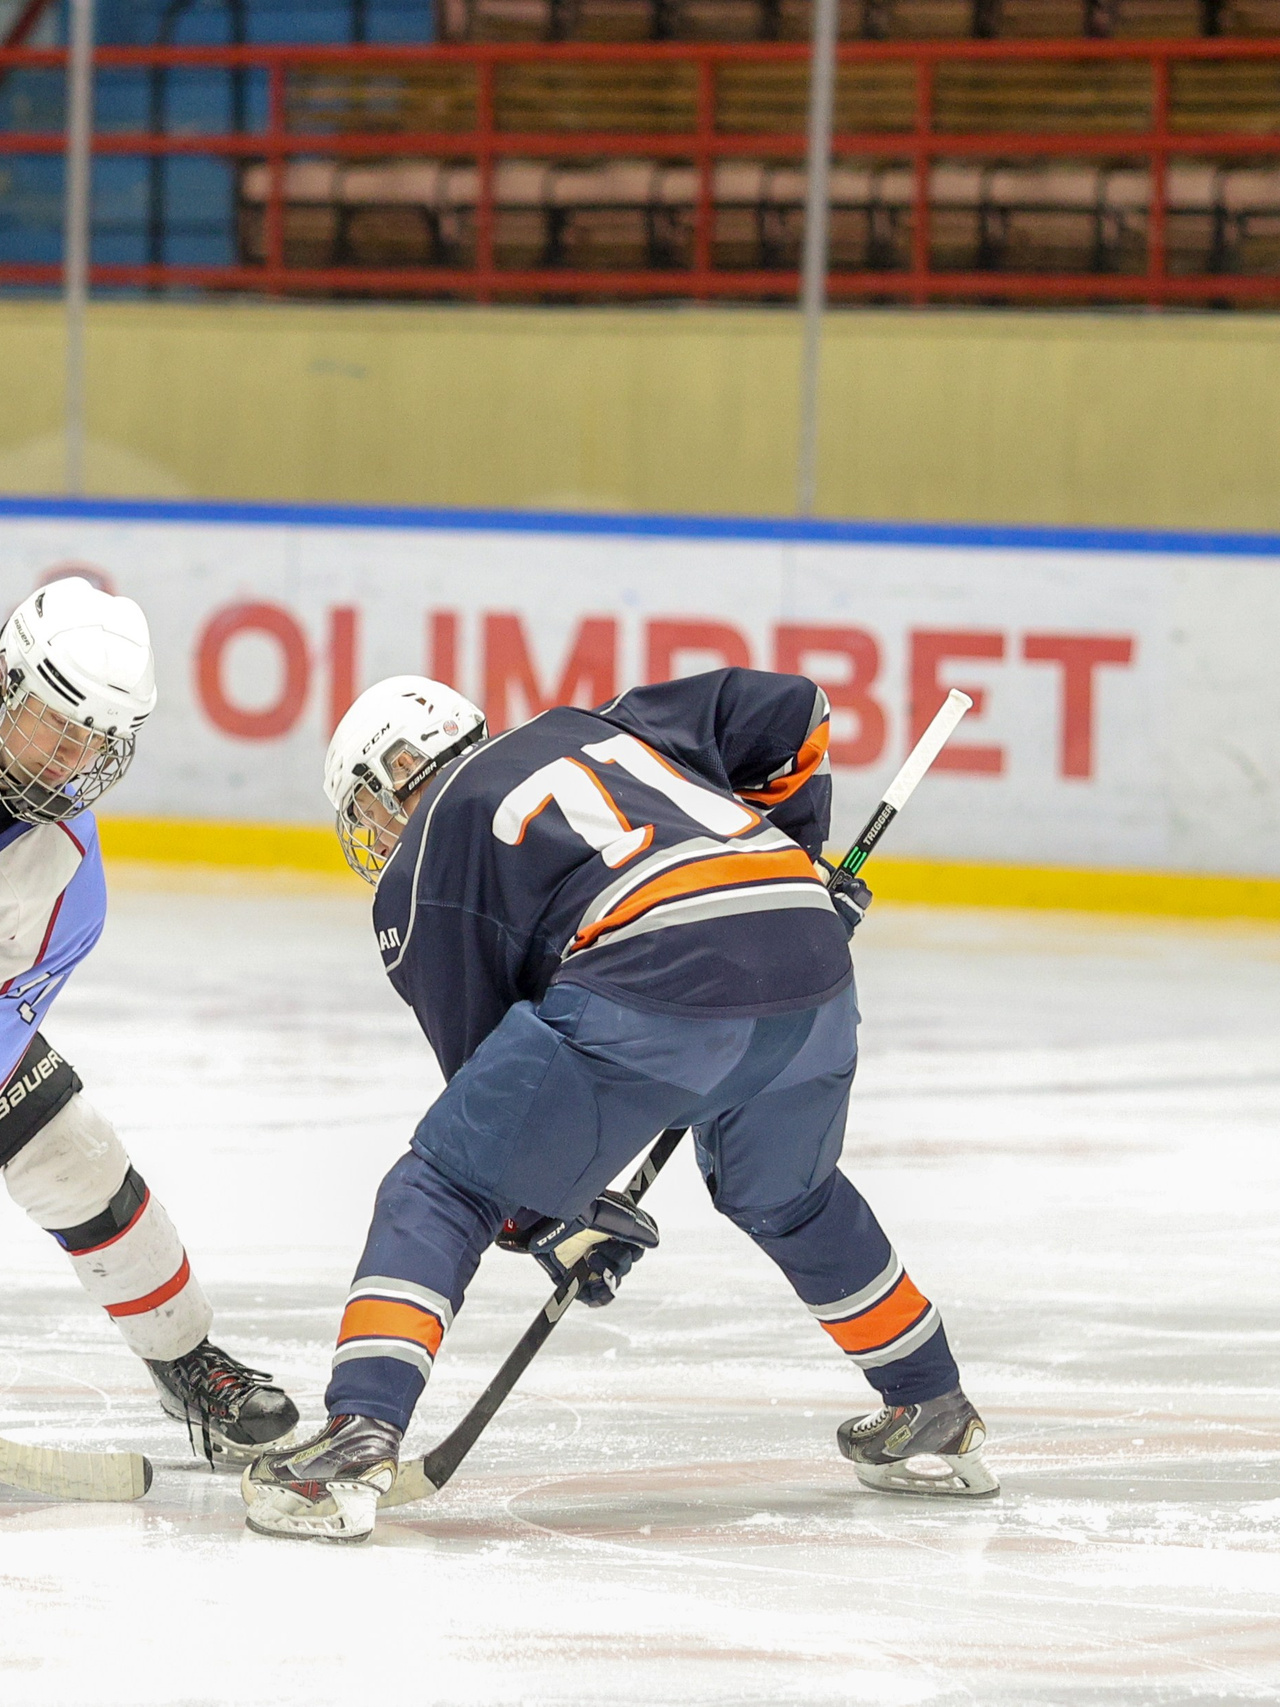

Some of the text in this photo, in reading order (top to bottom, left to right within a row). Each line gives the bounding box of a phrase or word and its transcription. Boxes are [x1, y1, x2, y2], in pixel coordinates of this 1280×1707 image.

[13, 618, 31, 647] BAUER
[362, 722, 390, 755] CCM
[407, 760, 438, 792] BAUER
[492, 733, 762, 870] 71
[862, 804, 894, 846] TRIGGER
[379, 926, 401, 951] АЛ
